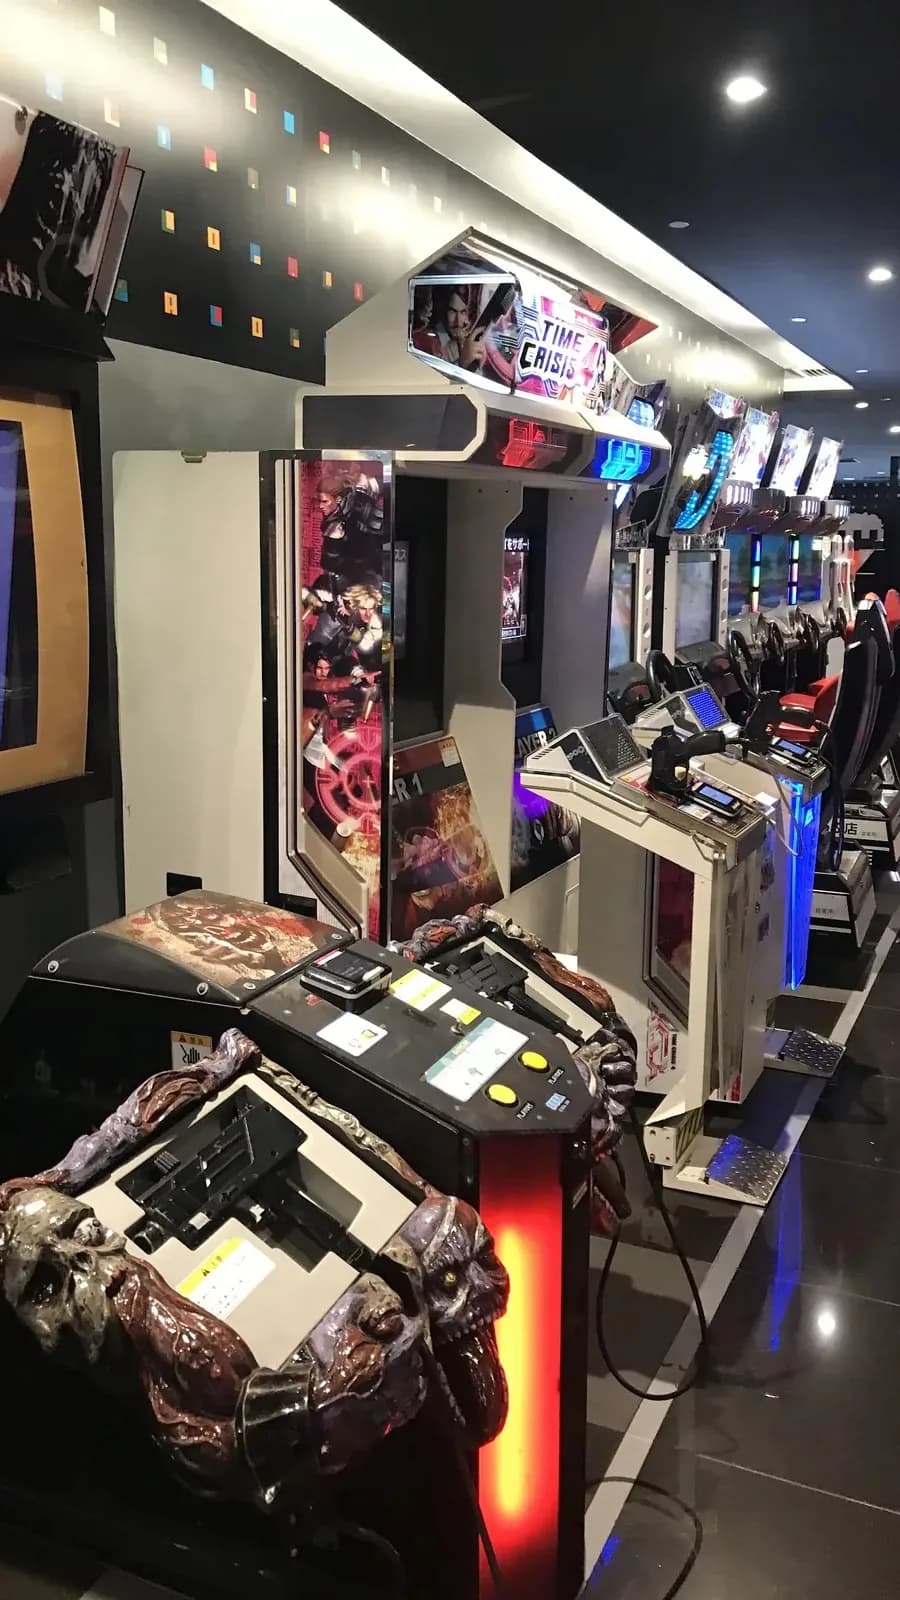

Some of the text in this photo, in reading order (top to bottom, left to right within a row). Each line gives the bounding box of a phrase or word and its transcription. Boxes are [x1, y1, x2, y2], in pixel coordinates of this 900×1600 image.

[542, 319, 585, 353] TIME
[519, 341, 577, 380] CRISIS
[412, 772, 424, 796] 1
